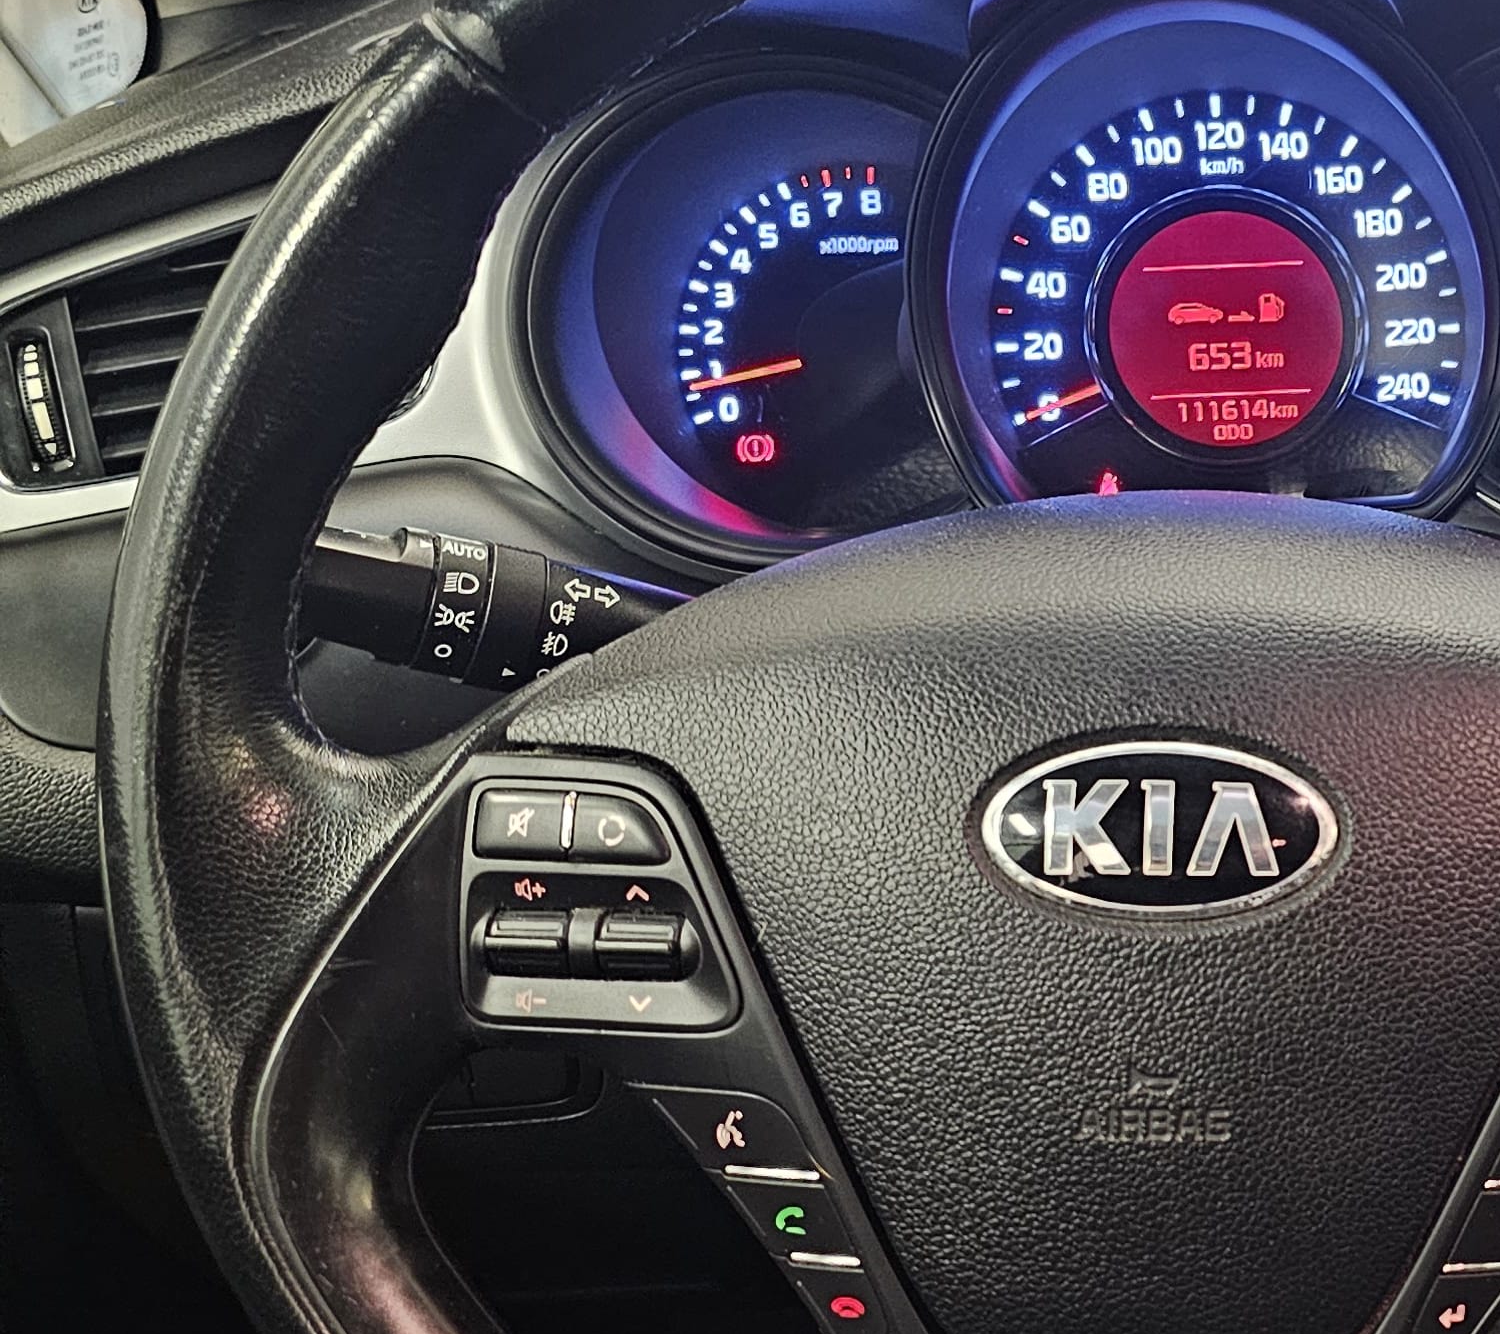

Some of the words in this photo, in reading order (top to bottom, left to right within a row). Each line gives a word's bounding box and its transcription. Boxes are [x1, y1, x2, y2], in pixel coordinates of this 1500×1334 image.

[1195, 121, 1245, 151] 120
[1259, 131, 1309, 162] 140
[1132, 137, 1182, 166] 100
[1200, 157, 1244, 175] km/h
[1314, 166, 1363, 194] 160
[1087, 172, 1128, 202] 80
[789, 202, 810, 228] 6
[823, 192, 843, 217] 7
[860, 189, 882, 215] 8
[758, 223, 779, 249] 5
[1050, 215, 1090, 243] 60
[1354, 208, 1402, 238] 180
[819, 236, 899, 255] x1000rpm
[730, 248, 752, 274] 4
[1026, 271, 1067, 299] 40
[1376, 264, 1427, 291] 200
[714, 282, 734, 308] 3
[704, 319, 724, 345] 2
[1023, 332, 1064, 360] 20
[1385, 318, 1436, 346] 220
[708, 359, 723, 381] 1
[1188, 341, 1252, 371] 653
[1377, 374, 1429, 402] 240
[719, 396, 740, 422] 0
[1038, 394, 1061, 422] 0
[1213, 423, 1254, 441] ODO
[441, 542, 487, 561] AUTO
[1042, 778, 1281, 876] KIA
[1072, 1109, 1234, 1143] AIRBAG
